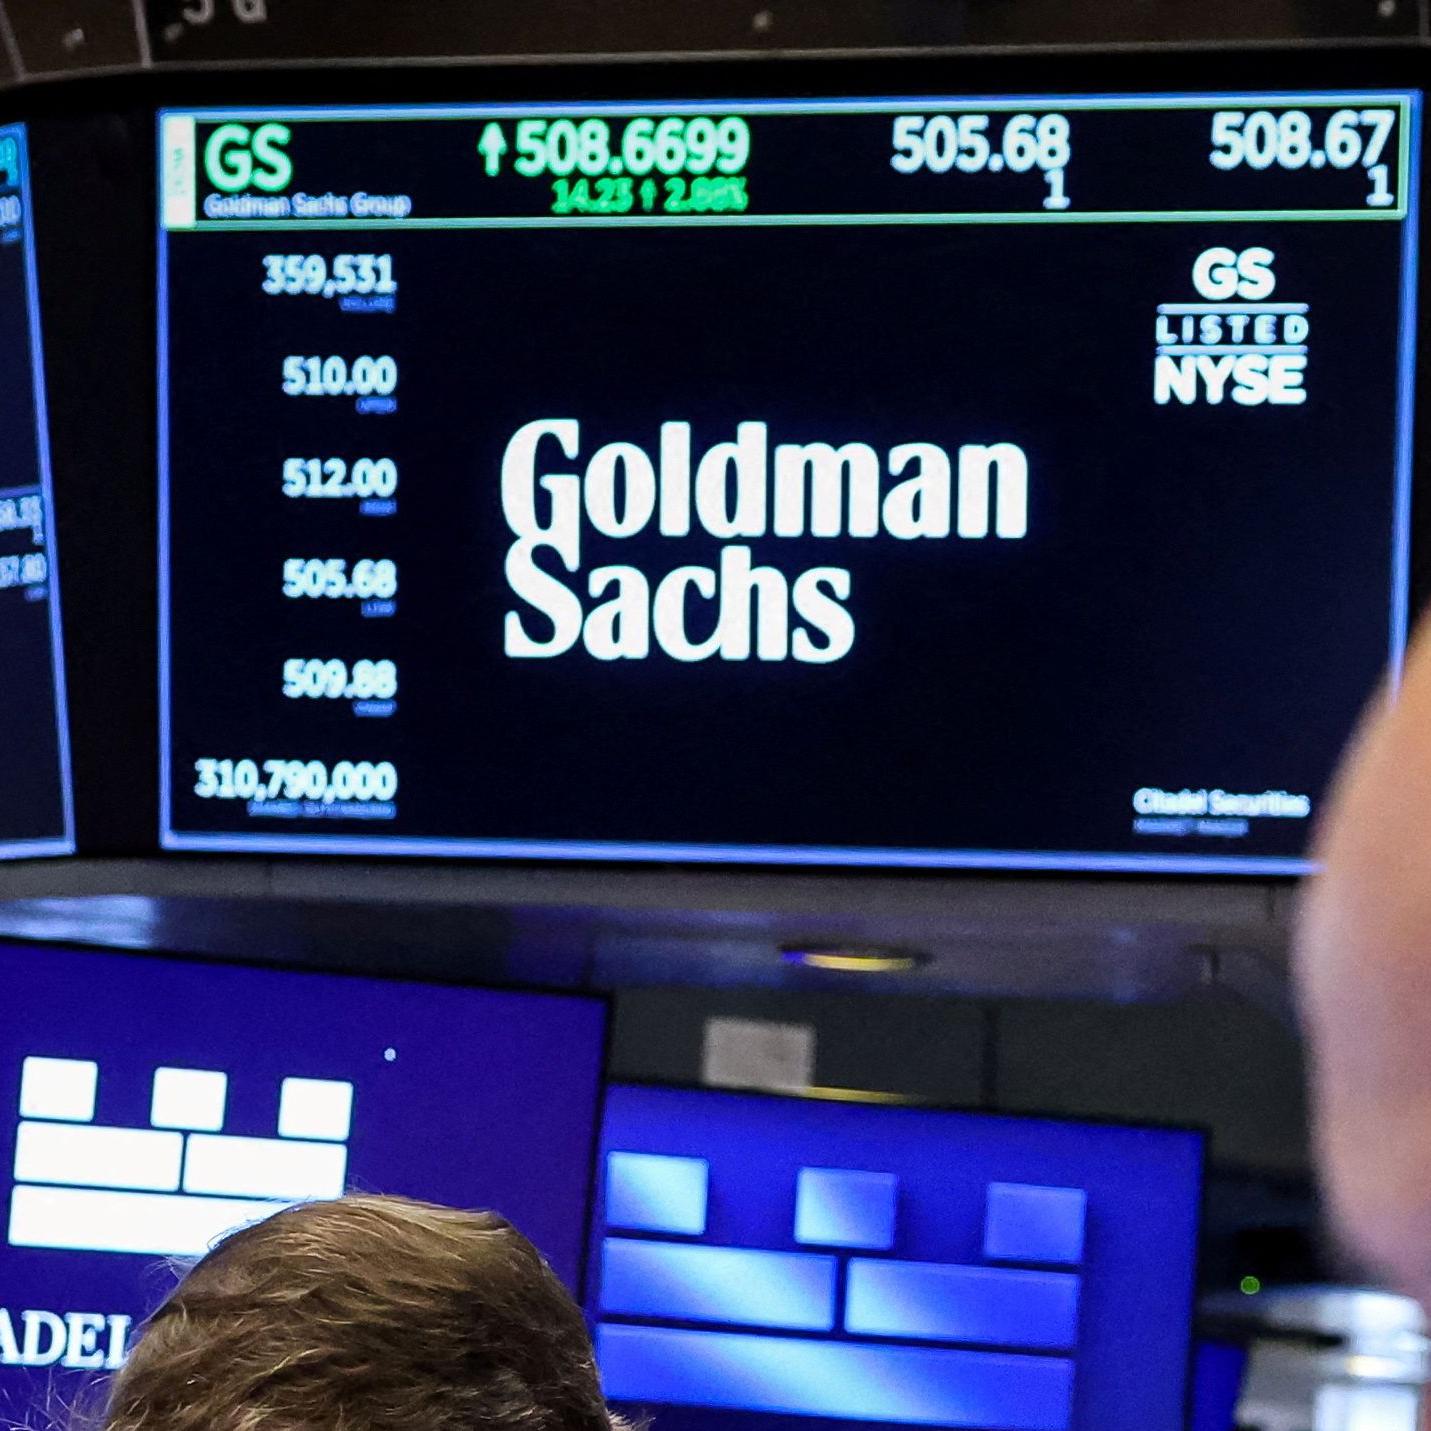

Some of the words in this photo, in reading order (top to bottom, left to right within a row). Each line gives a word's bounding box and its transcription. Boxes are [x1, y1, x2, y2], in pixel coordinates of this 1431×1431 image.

[204, 123, 293, 192] GS
[514, 116, 751, 177] 508.6699
[890, 114, 1070, 173] 505.68
[1210, 110, 1396, 170] 508.67
[1042, 168, 1071, 209] 1
[1365, 164, 1394, 206] 1
[262, 254, 398, 299] 359,531
[1192, 246, 1276, 301] GS
[1155, 314, 1310, 344] LISTED
[282, 355, 398, 396] 510.00
[1153, 354, 1308, 406] NYSE
[282, 457, 398, 499] 512.00
[500, 419, 1029, 571] Goldman
[282, 558, 398, 599] 505.68
[504, 534, 857, 664] Sachs
[194, 758, 398, 805] 310,790,000
